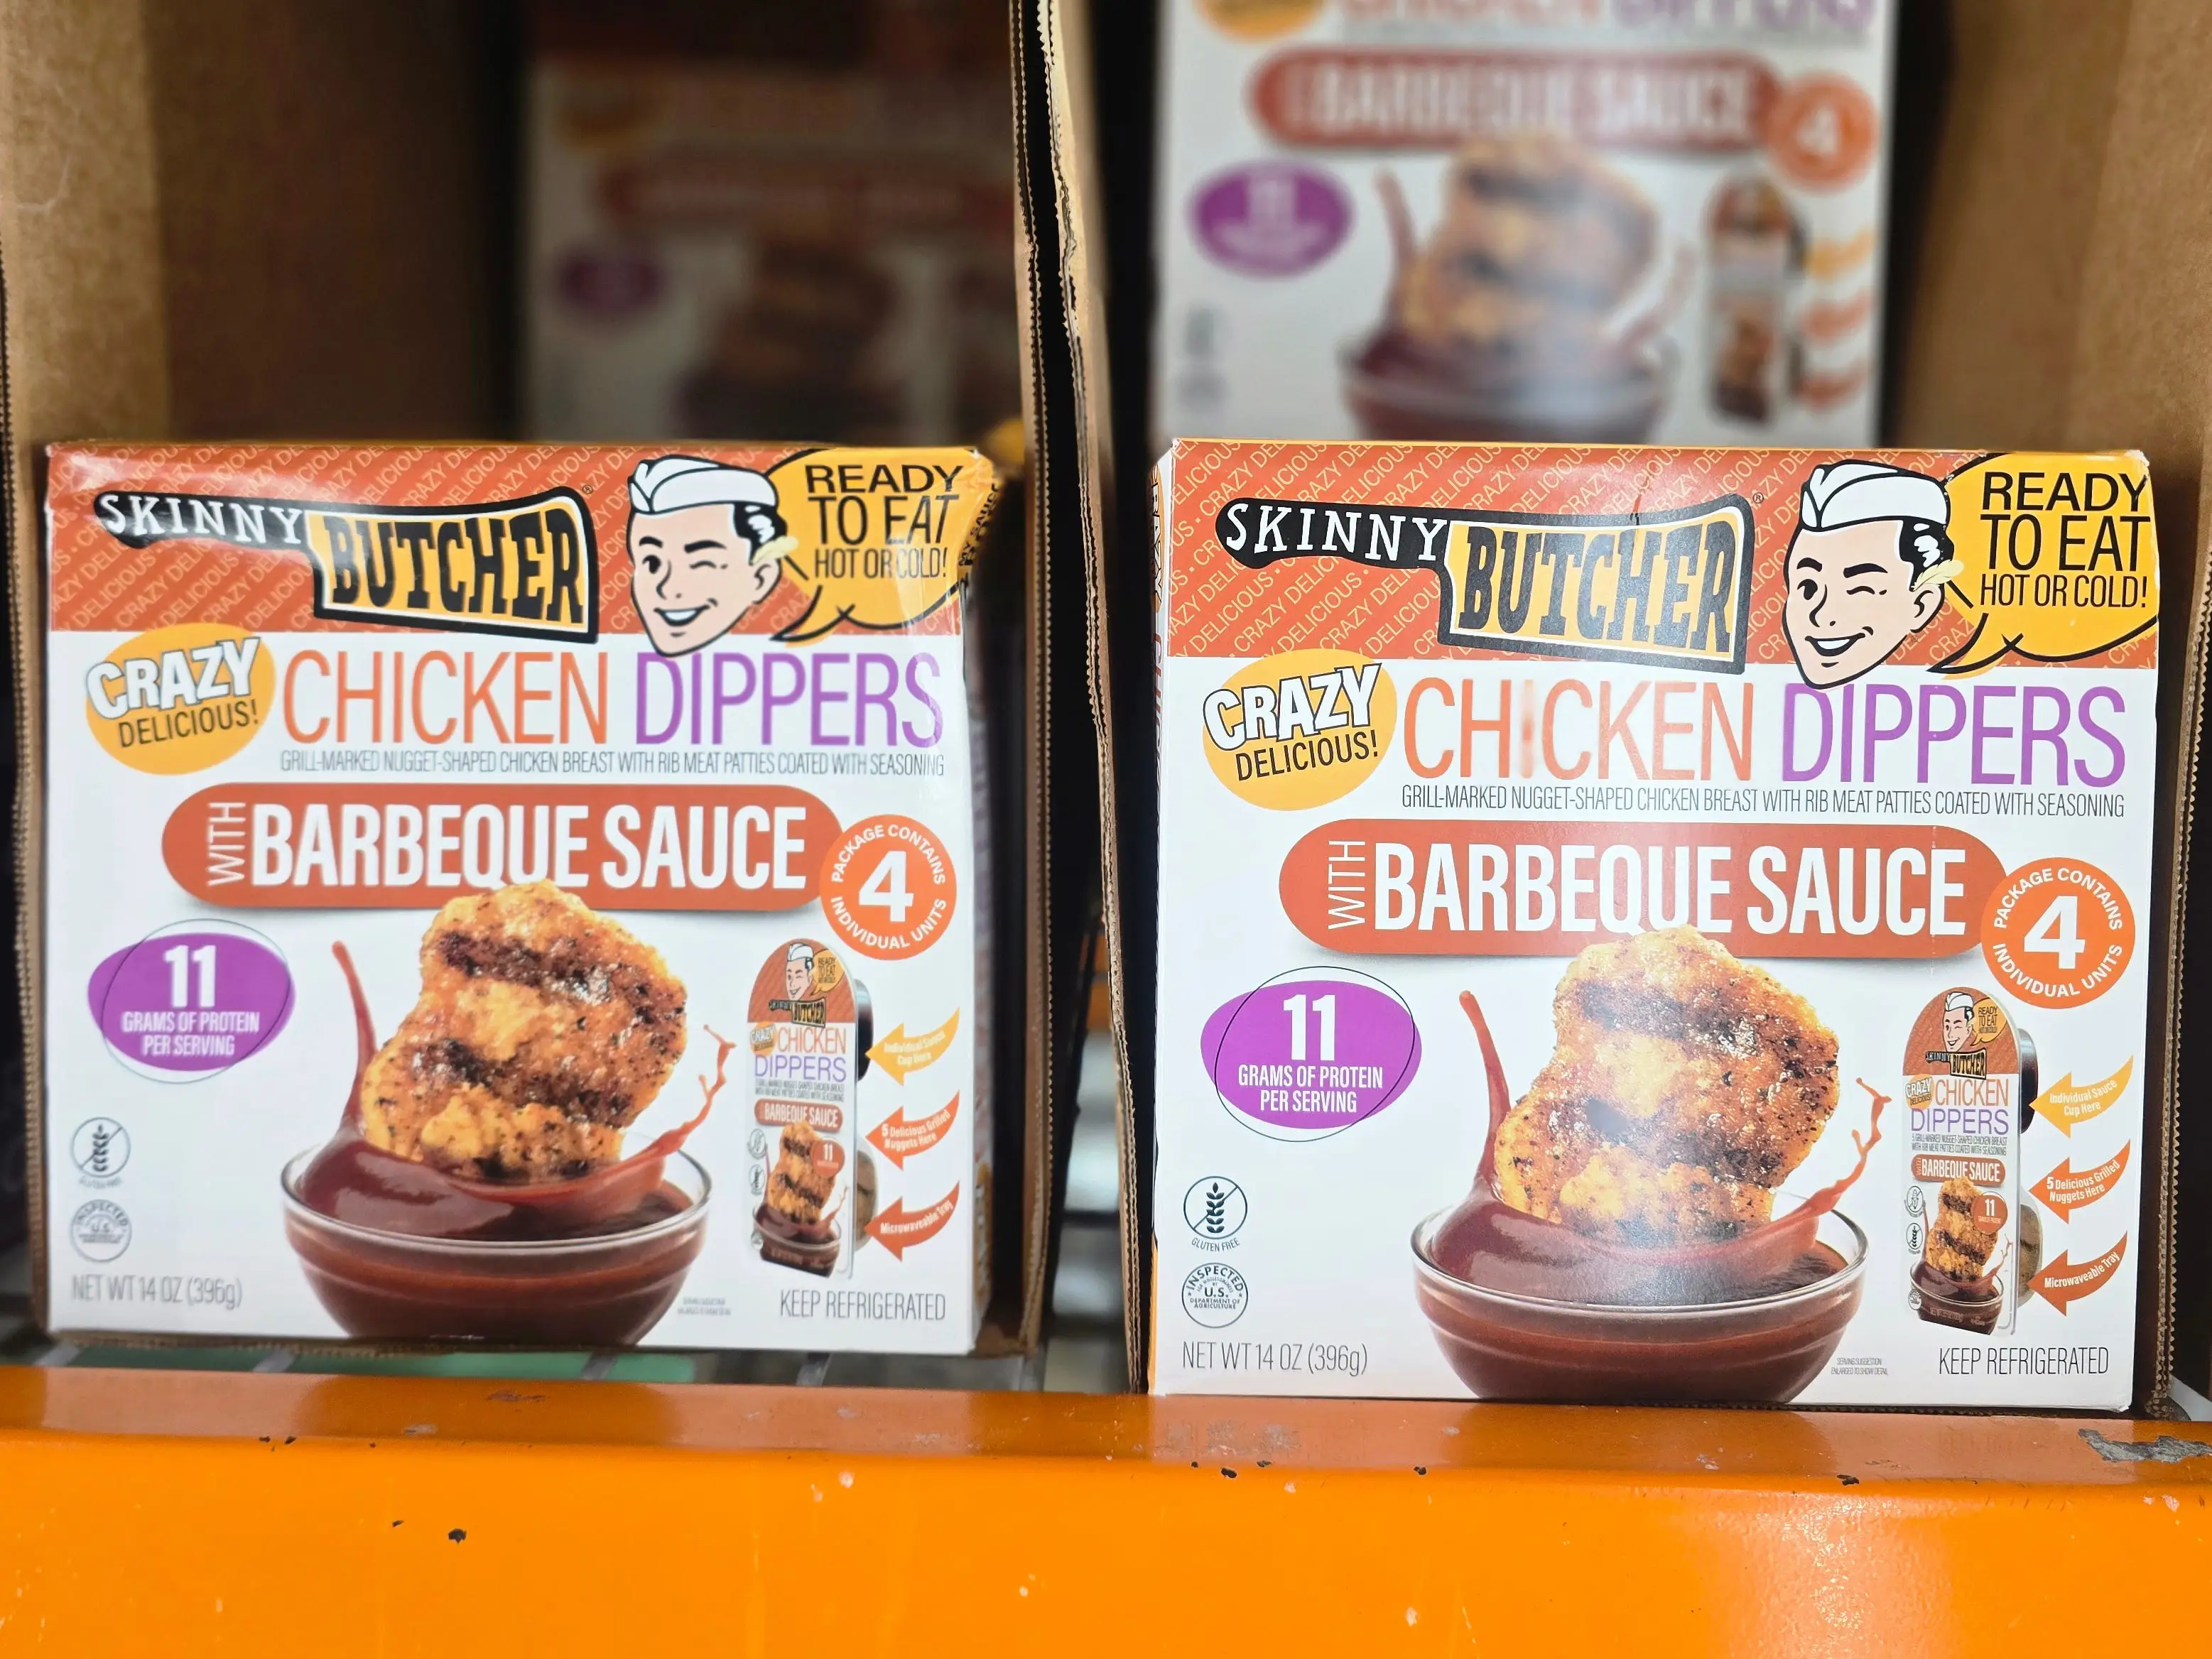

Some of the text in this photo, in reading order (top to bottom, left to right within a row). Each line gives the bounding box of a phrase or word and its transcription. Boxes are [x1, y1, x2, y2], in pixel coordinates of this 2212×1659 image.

[806, 464, 964, 494] READY
[1200, 467, 1248, 516] CRAZY
[1983, 472, 2150, 512] READY
[808, 495, 960, 545] TO EAT
[100, 494, 582, 624] SKINNY BUTCHER
[1981, 513, 2151, 572] TO EAT
[815, 547, 948, 578] HOT OR COLD!
[1226, 503, 1737, 653] SKINNY BUTCHER
[73, 546, 156, 628] DELICIOUS
[116, 577, 169, 629] CRAZY
[160, 550, 242, 630] DELICIOUS
[202, 580, 253, 628] CRAZY
[1981, 574, 2147, 608] HOT OR COLD!
[1190, 575, 1274, 653] DELICIOUS
[1234, 598, 1287, 653] CRAZY
[1279, 572, 1363, 653] DELICIOUS
[1320, 599, 1371, 649] CRAZY
[1366, 576, 1441, 653] DELICIOUS
[85, 637, 261, 720] CRAZY
[283, 650, 944, 748] CHICKEN DIPPERS
[1203, 663, 1382, 751] CRAZY
[118, 700, 259, 749] DELICIOUS!
[1404, 677, 2125, 788] CHICKEN DIPPERS
[281, 750, 944, 777] GRILL-MARKED NUGGET-SHAPED CHICKEN BREAST WITH RIB MEAT PATTIES COATED WITH SEASONING
[1235, 730, 1379, 781] DELICIOUS!
[1402, 785, 2124, 817] GRILL-MARKED NUGGET-SHAPED CHICKEN BREAST WITH RIB MEAT PATTIES COATED WITH SEASONING
[207, 801, 807, 890] WITH BARBEQUE SAUCE
[831, 824, 945, 886] PACKAGE CONTAINS
[858, 850, 913, 923] 4
[1328, 841, 1966, 936] WITH BARBEQUE SAUCE
[1993, 867, 2123, 930] PACKAGE CONTAINS
[830, 896, 947, 950] INDIVIDUAL UNITS
[2024, 896, 2085, 969] 4
[164, 945, 216, 1008] 11
[1993, 942, 2123, 999] INDIVIDUAL UNITS
[121, 1011, 260, 1034] GRAMS OF PROTEIN
[1283, 994, 1335, 1061] 11
[1978, 1006, 1997, 1015] READY
[1978, 1014, 1997, 1026] TO EAT
[143, 1035, 235, 1057] PER SERVING
[778, 1028, 847, 1054] CHICKEN
[754, 1055, 847, 1082] DIPPERS
[1238, 1065, 1382, 1088] GRAMS OF PROTEIN
[1953, 1053, 1985, 1076] BUTCHER
[1260, 1090, 1357, 1113] PER SERVING
[1905, 1077, 1932, 1098] CRAZY
[1935, 1079, 2009, 1106] CHICKEN
[2049, 1079, 2117, 1103] Individual Sauce
[808, 1105, 838, 1128] SAUCE
[1911, 1109, 2009, 1135] DIPPERS
[2064, 1102, 2101, 1118] Cup Here
[890, 1124, 927, 1138] Delicious
[1921, 1158, 1968, 1178] BARBEQUE
[1968, 1162, 2000, 1182] SAUCE
[2046, 1159, 2120, 1190] 5 Delicious Grilled
[1985, 1199, 1995, 1216] 11
[2049, 1183, 2105, 1204] Nuggets Here
[1191, 1237, 1240, 1251] GLUTEN FREE
[1186, 1266, 1244, 1291] INSPECTED
[2044, 1251, 2120, 1288] Microwaveable Tray
[72, 1275, 242, 1310] NET WT 14 OZ (396g)
[780, 1290, 945, 1321] KEEP REFRIGERATED
[1204, 1287, 1228, 1298] U.S.
[1183, 1341, 1367, 1376] NET WT 14 OZ (396g)
[1940, 1347, 2108, 1374] KEEP REFRIGERATED
